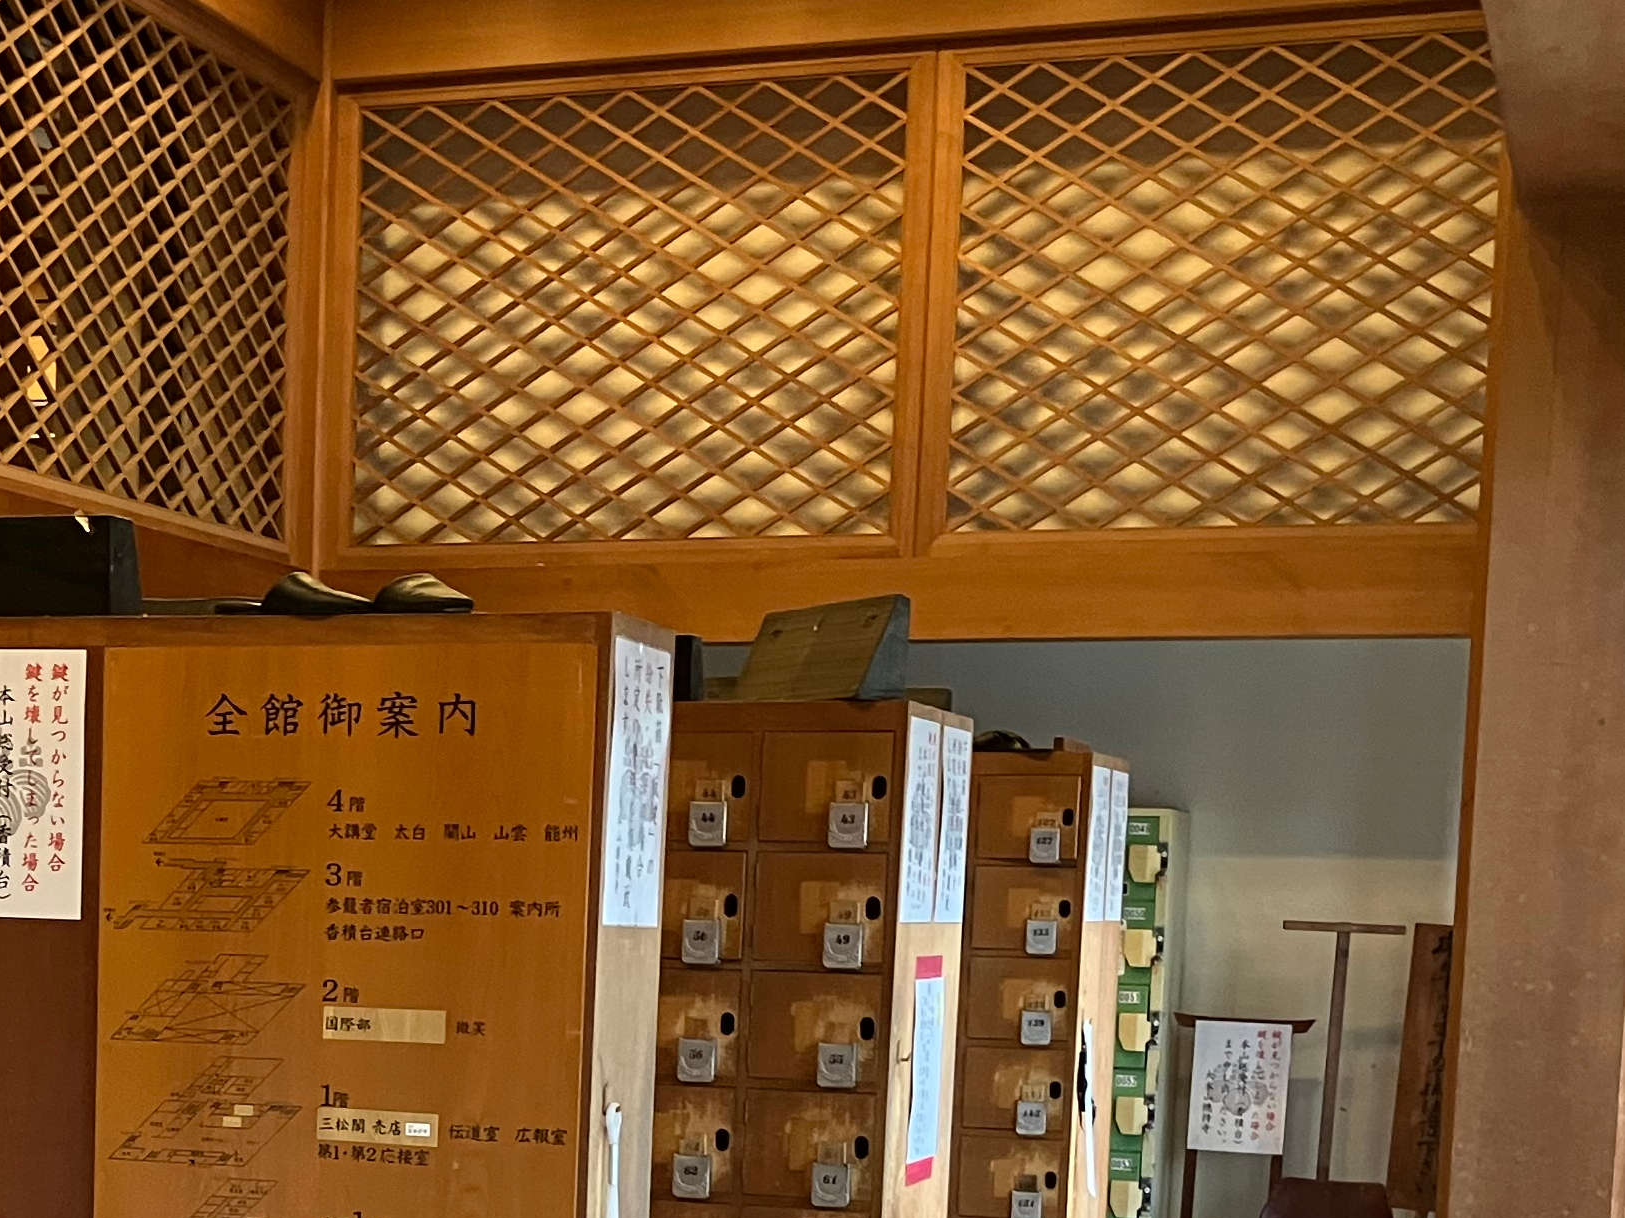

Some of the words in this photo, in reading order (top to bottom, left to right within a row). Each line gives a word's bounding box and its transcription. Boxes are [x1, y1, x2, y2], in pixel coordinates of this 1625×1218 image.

[205, 691, 478, 738] 全館御案内
[21, 663, 42, 893] 鍵を壊してしまった場合
[48, 663, 69, 872] 鍵が見つからない場合
[327, 790, 365, 813] 4階
[841, 814, 856, 825] 43
[328, 823, 375, 841] 大講堂
[395, 824, 426, 841] 太白
[326, 864, 363, 888] 3階
[510, 899, 561, 918] 案内所
[835, 934, 850, 946] 49
[322, 980, 359, 1003] 2階
[325, 1014, 371, 1033] 国際部
[1027, 1019, 1045, 1027] 139
[320, 1085, 349, 1108] 1階
[318, 1117, 365, 1135] 三松閣
[372, 1119, 401, 1137] 売店
[448, 1124, 500, 1143] 伝道室
[514, 1127, 568, 1146] 広報室
[823, 1174, 838, 1185] 61
